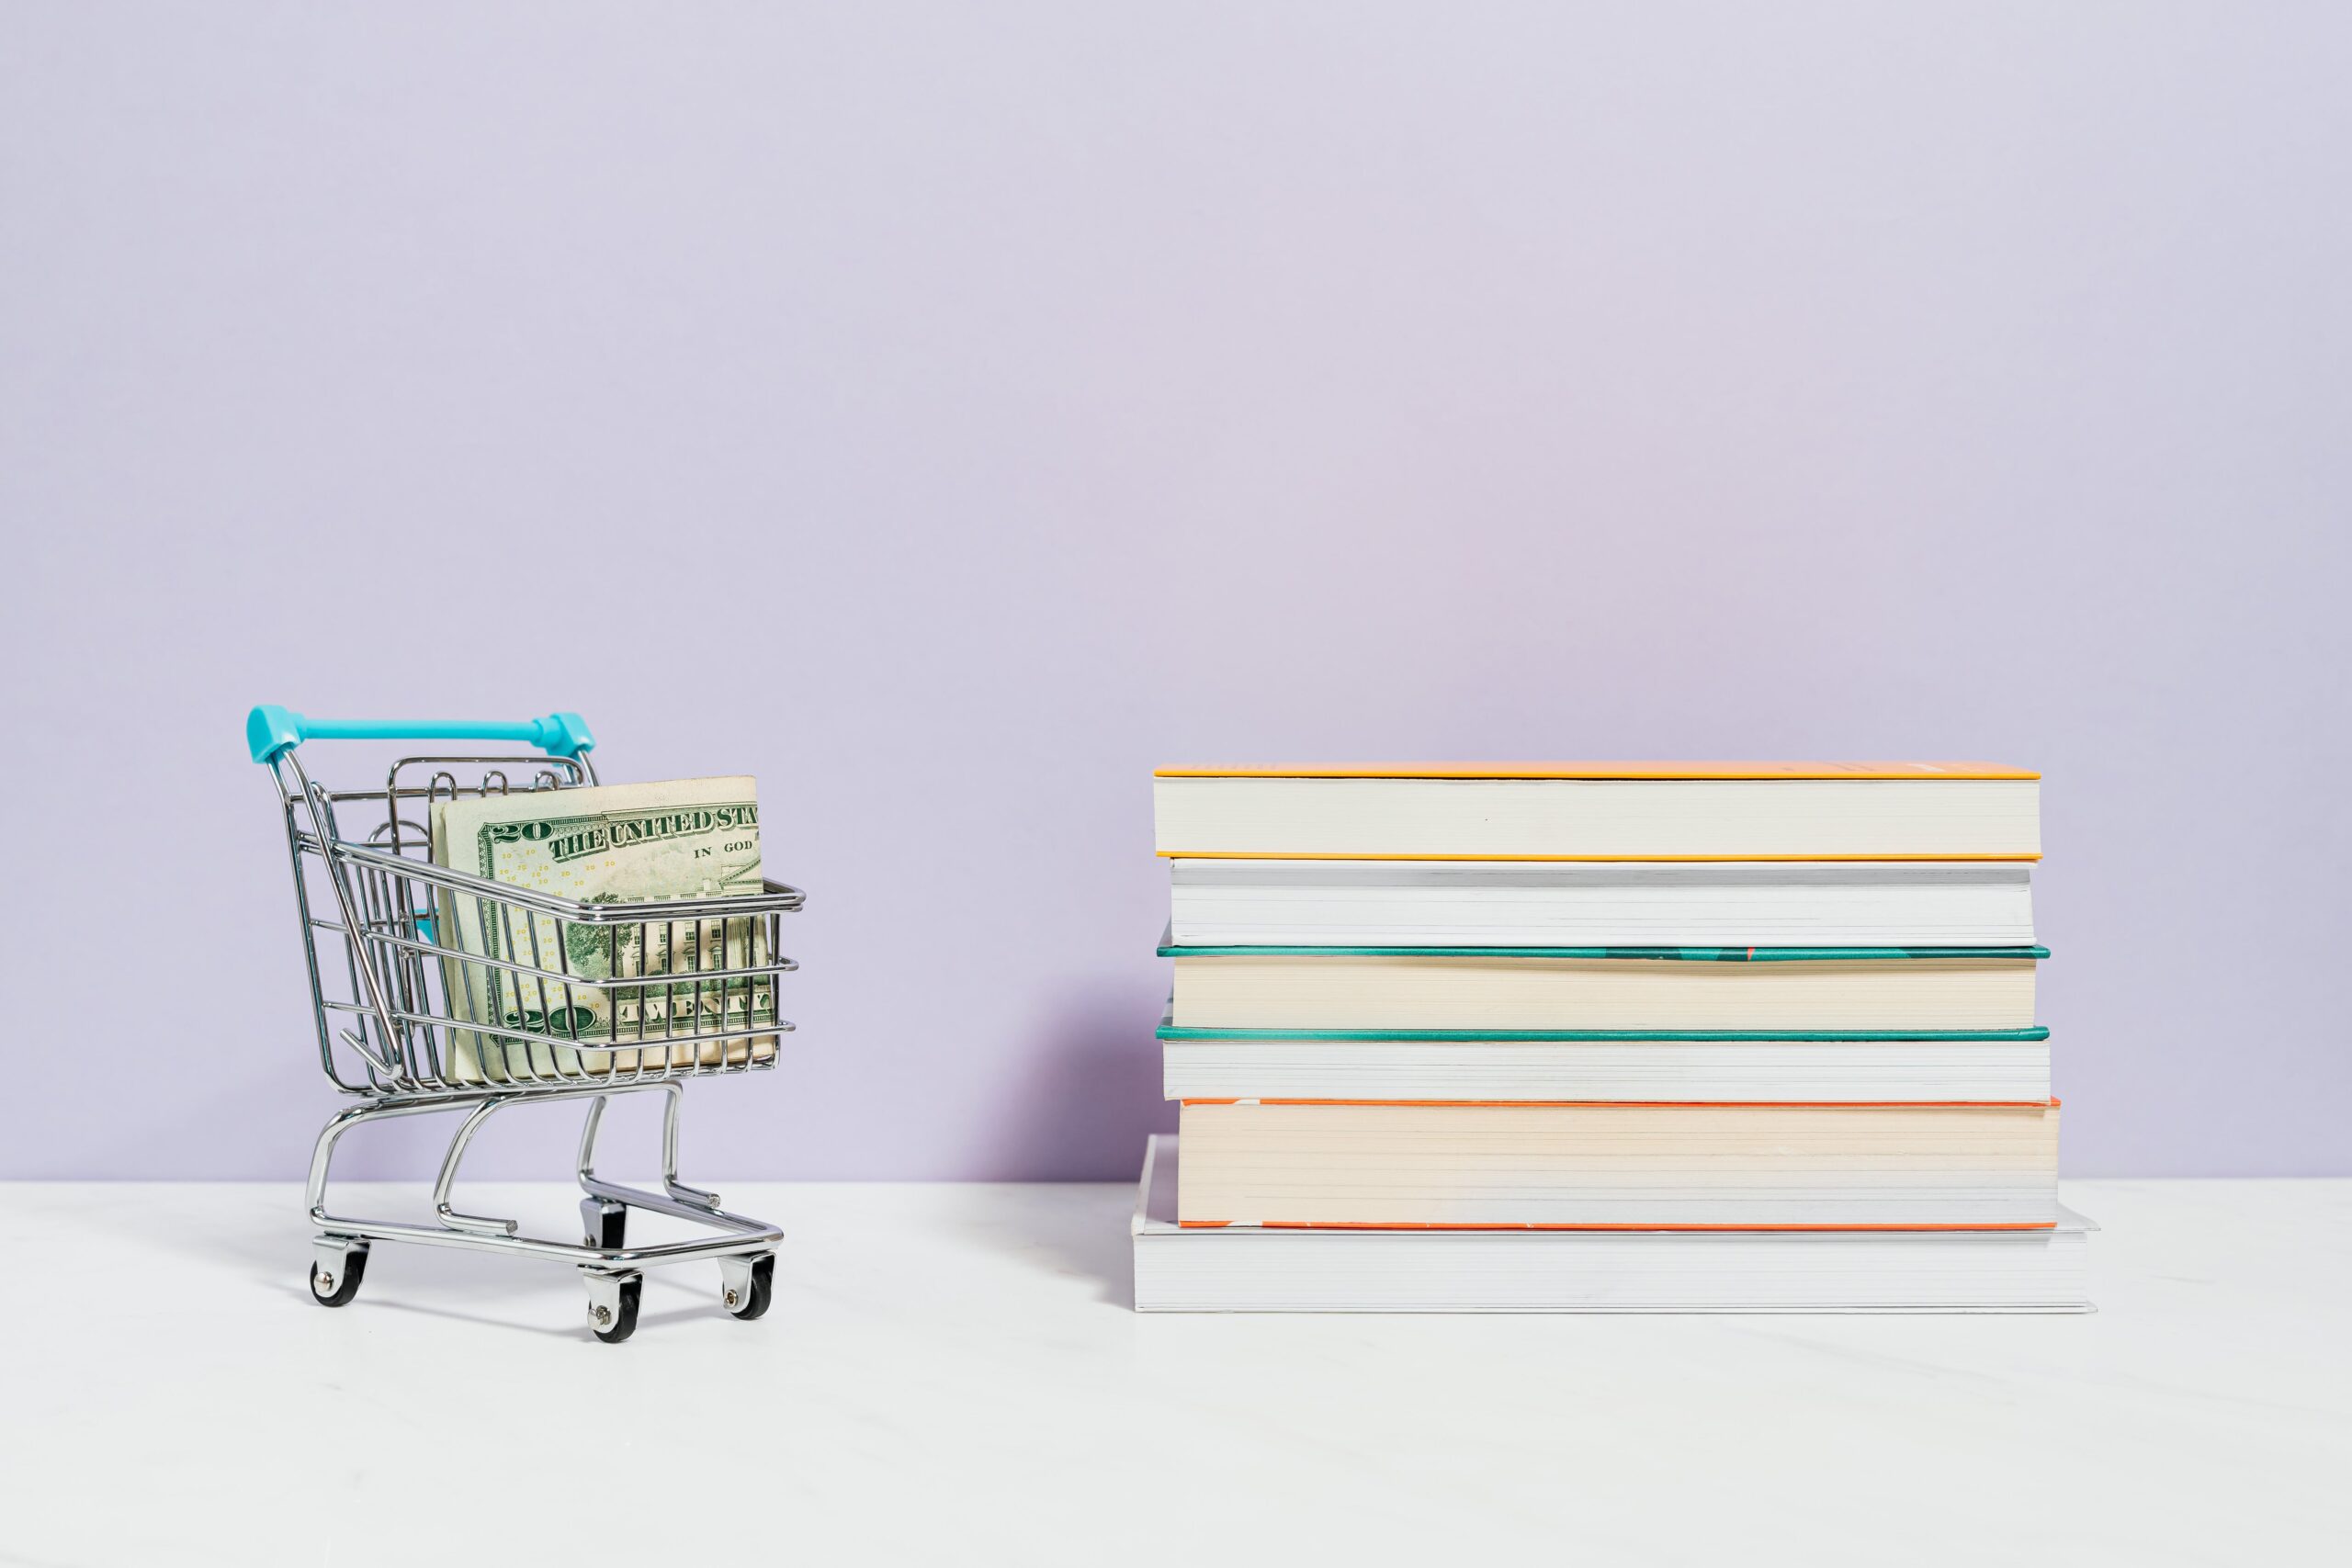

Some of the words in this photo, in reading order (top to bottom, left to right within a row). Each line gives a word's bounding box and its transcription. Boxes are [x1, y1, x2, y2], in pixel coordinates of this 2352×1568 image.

[491, 821, 554, 844] 20
[548, 829, 609, 863] THE
[608, 810, 717, 849] UNITED
[694, 846, 712, 860] IN
[724, 840, 752, 853] GOD
[504, 1005, 597, 1033] 20
